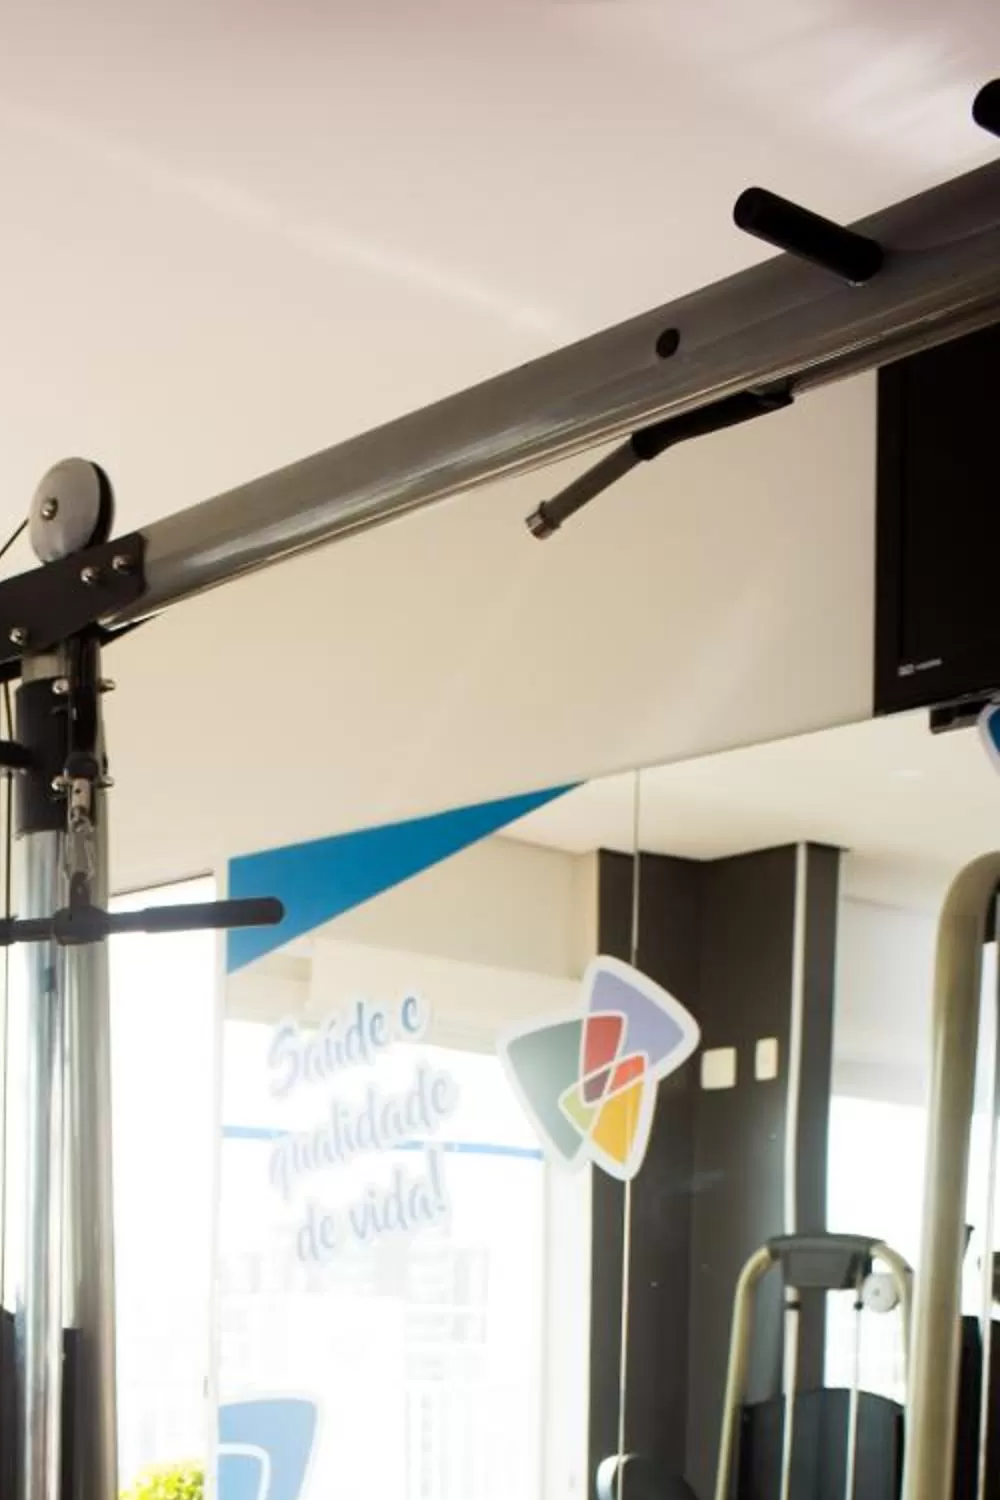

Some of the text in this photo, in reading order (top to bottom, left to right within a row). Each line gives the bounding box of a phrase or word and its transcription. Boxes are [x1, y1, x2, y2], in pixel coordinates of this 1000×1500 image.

[269, 995, 421, 1097] Saúde e
[269, 1066, 450, 1201] qualidade
[297, 1148, 448, 1262] de vida!
